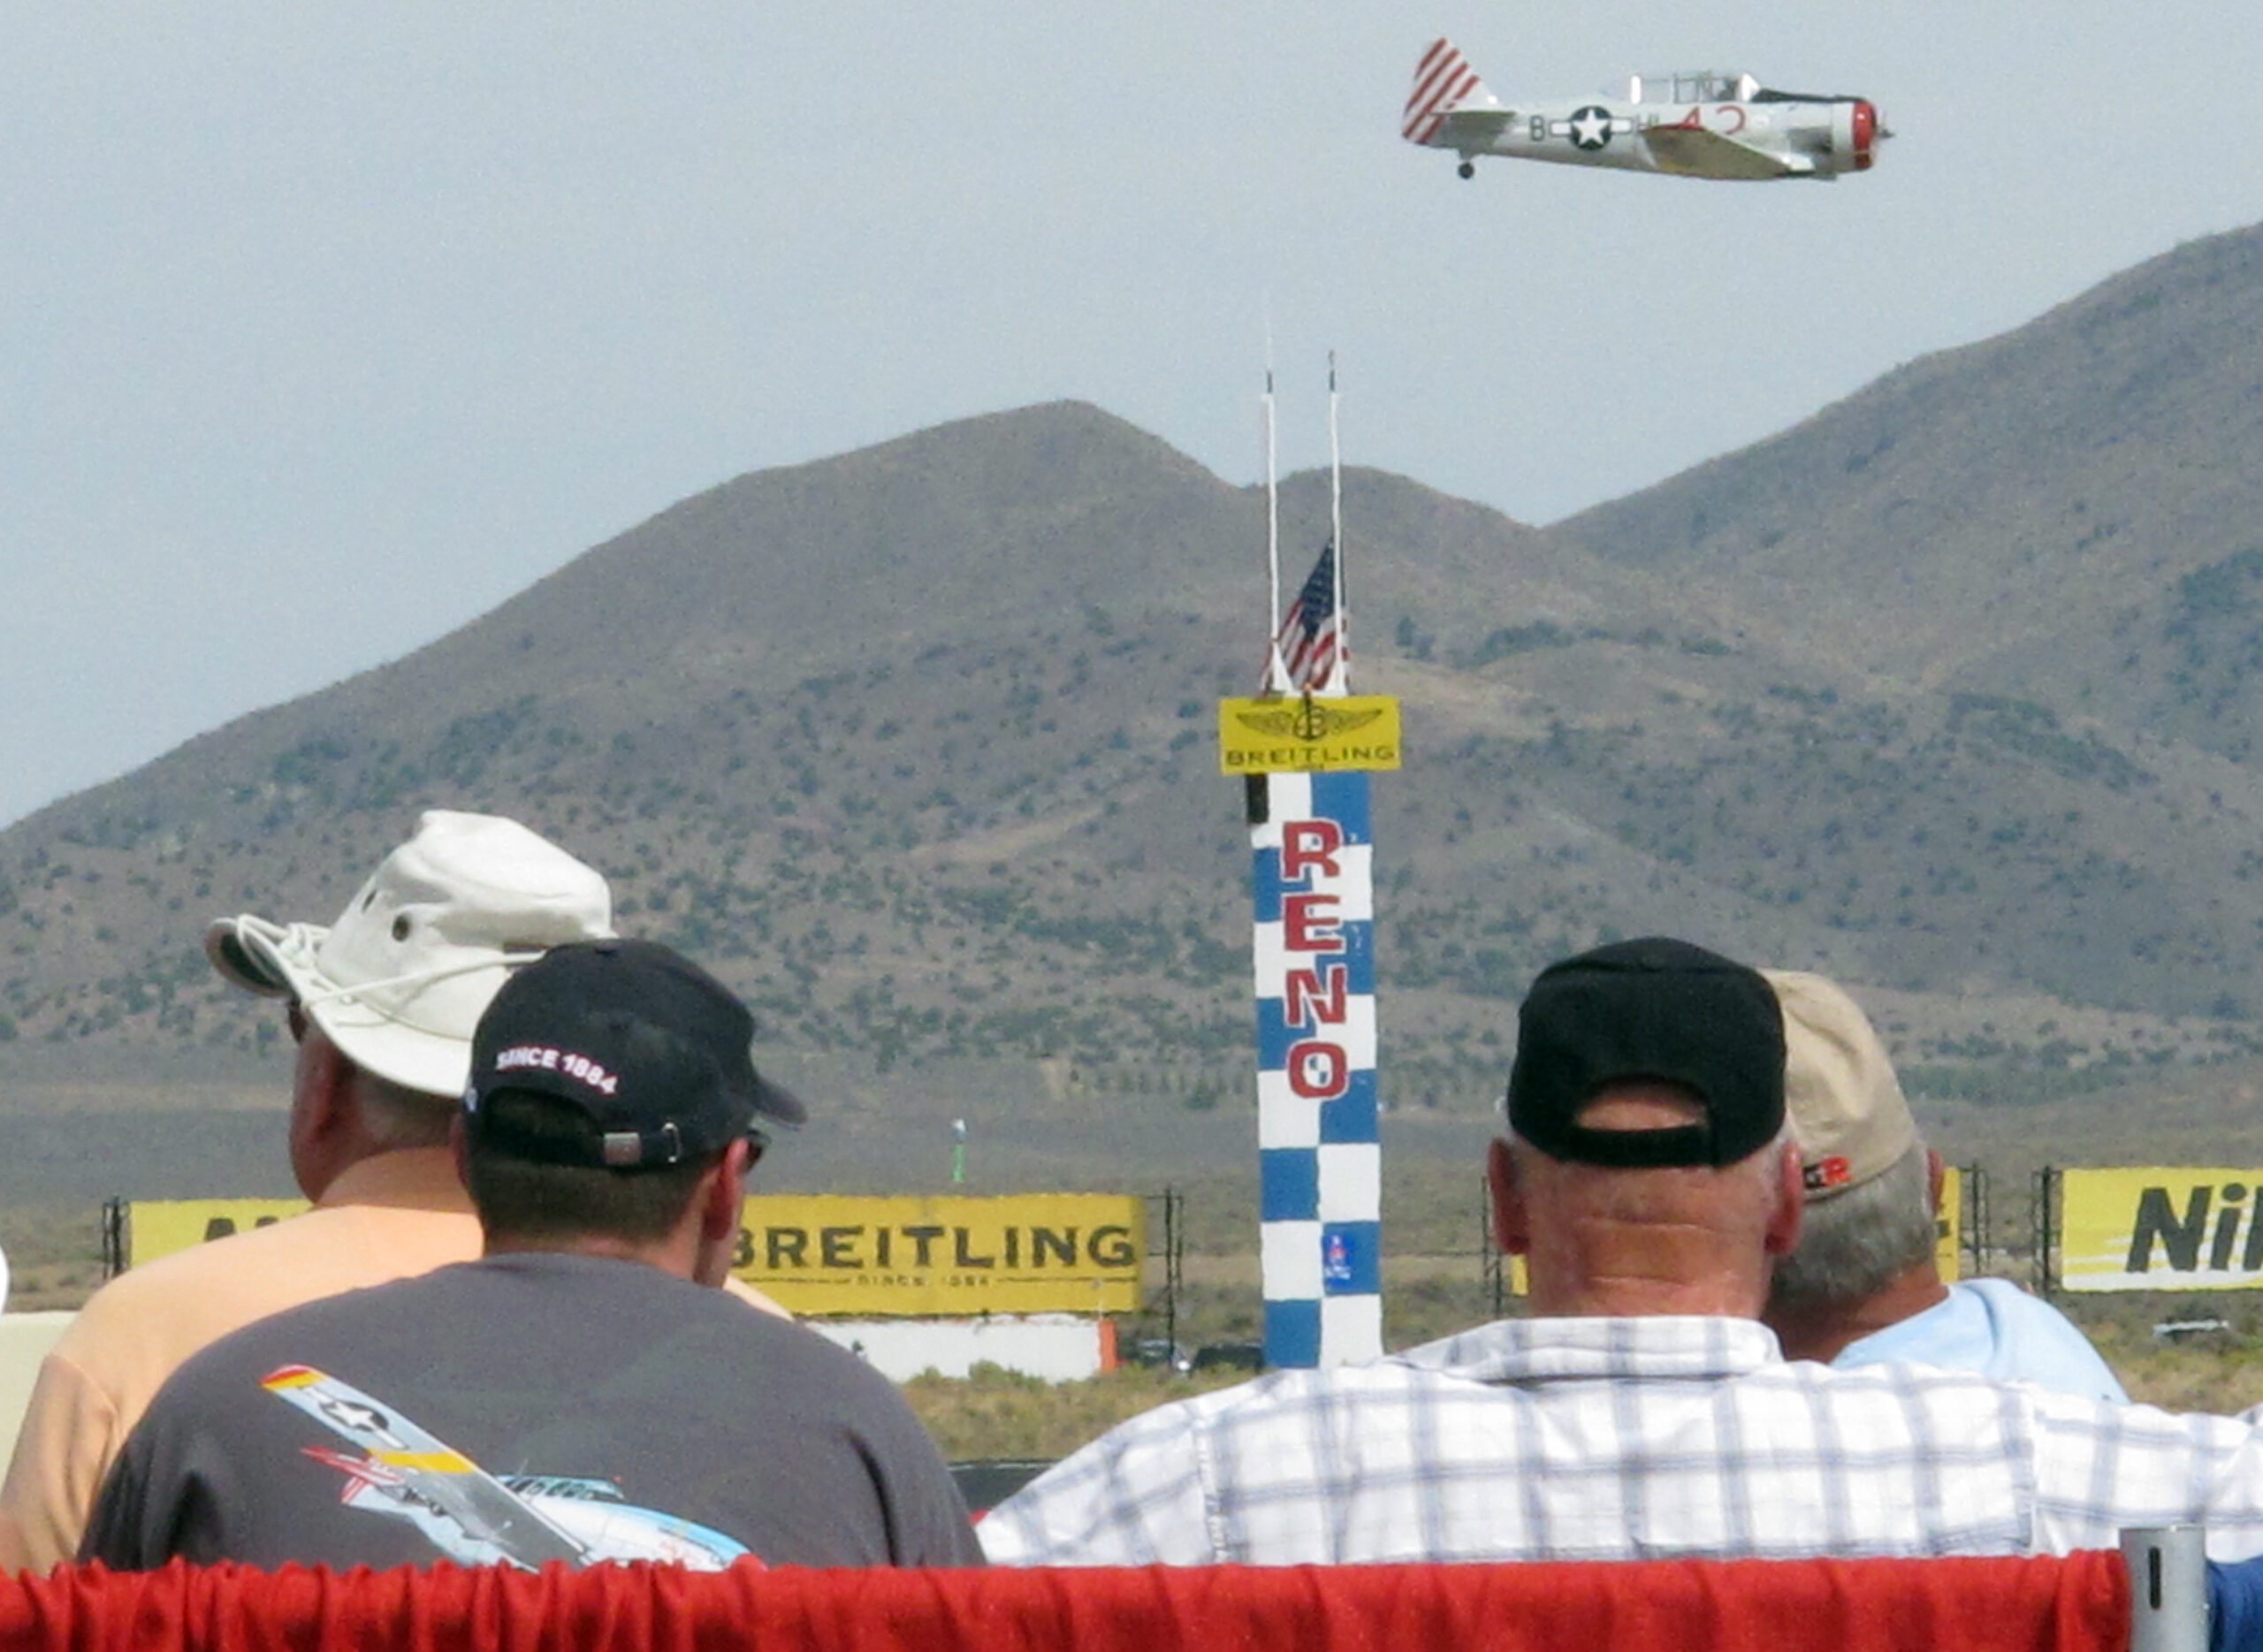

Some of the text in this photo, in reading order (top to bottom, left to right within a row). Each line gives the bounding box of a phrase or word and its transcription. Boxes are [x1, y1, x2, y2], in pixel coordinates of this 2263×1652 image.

[1226, 745, 1395, 766] BREITLING
[1281, 818, 1350, 1100] RENO
[495, 1047, 619, 1094] SINCE 1884
[731, 1225, 1135, 1269] BREITLING
